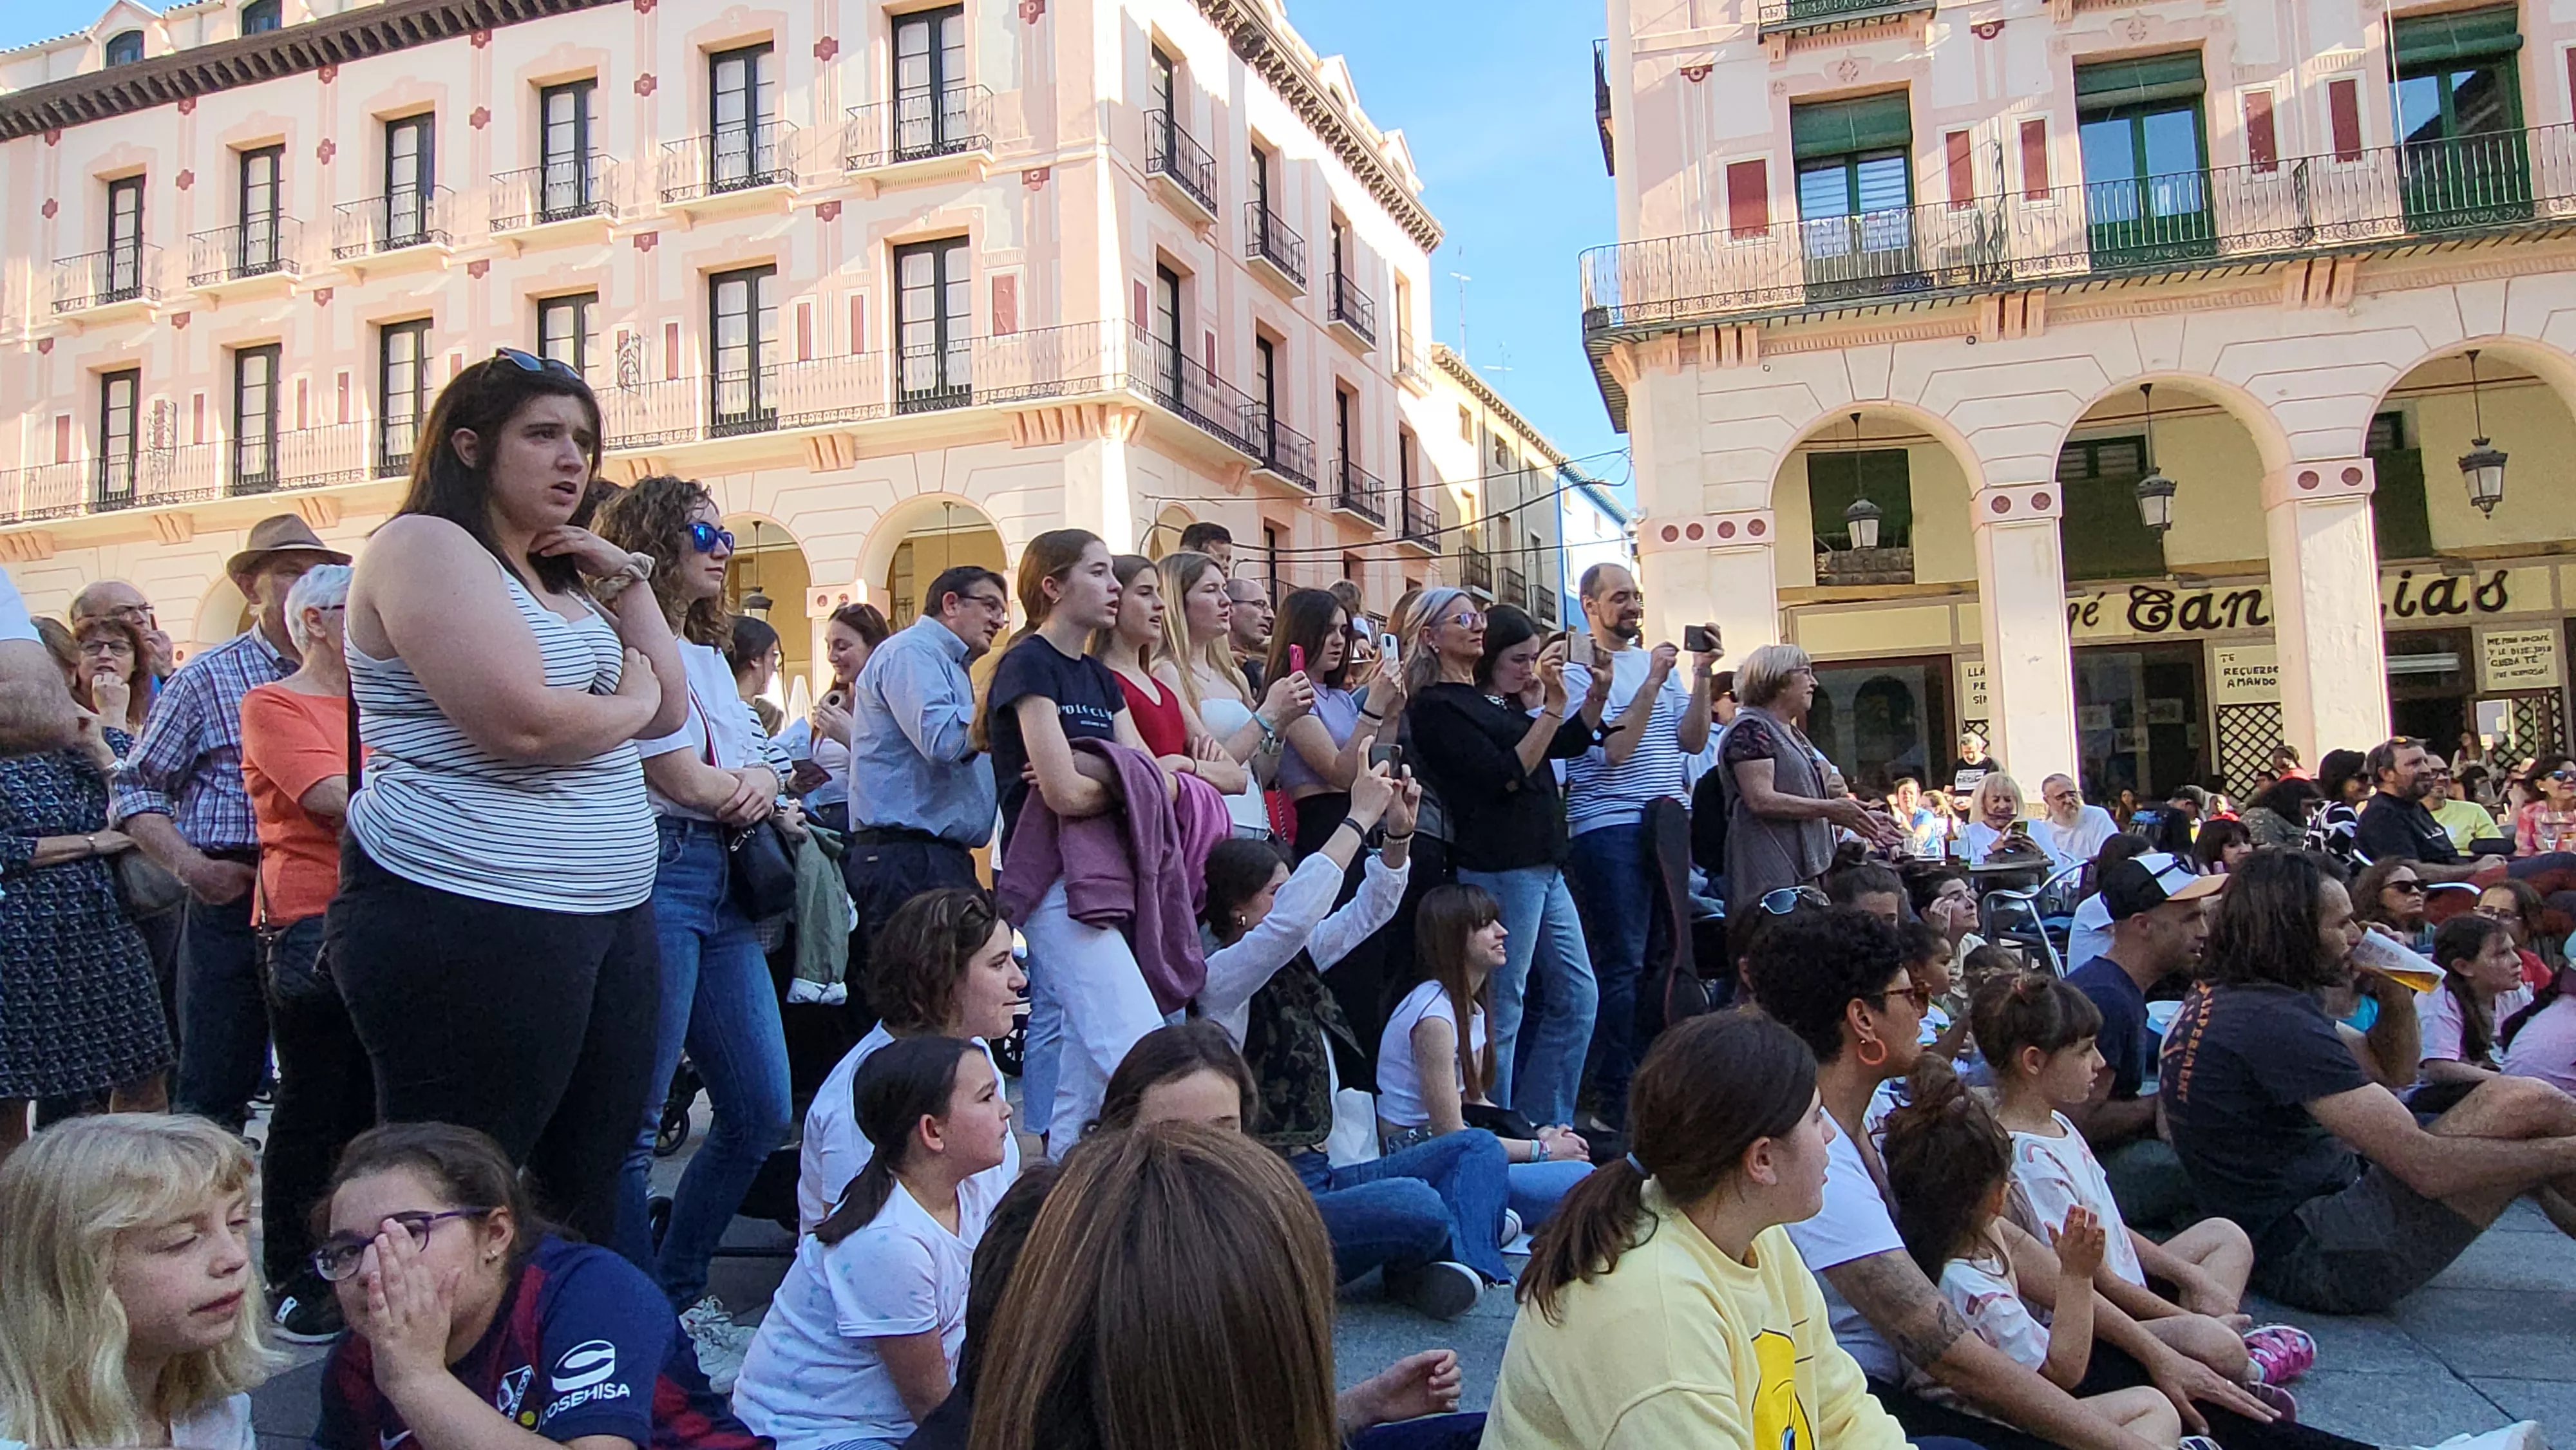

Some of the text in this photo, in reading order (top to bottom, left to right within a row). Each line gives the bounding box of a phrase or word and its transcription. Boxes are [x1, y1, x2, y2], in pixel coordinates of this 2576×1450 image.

[2219, 653, 2235, 663] TE
[1967, 664, 1985, 677] LLÁ
[1973, 682, 1986, 691] PE
